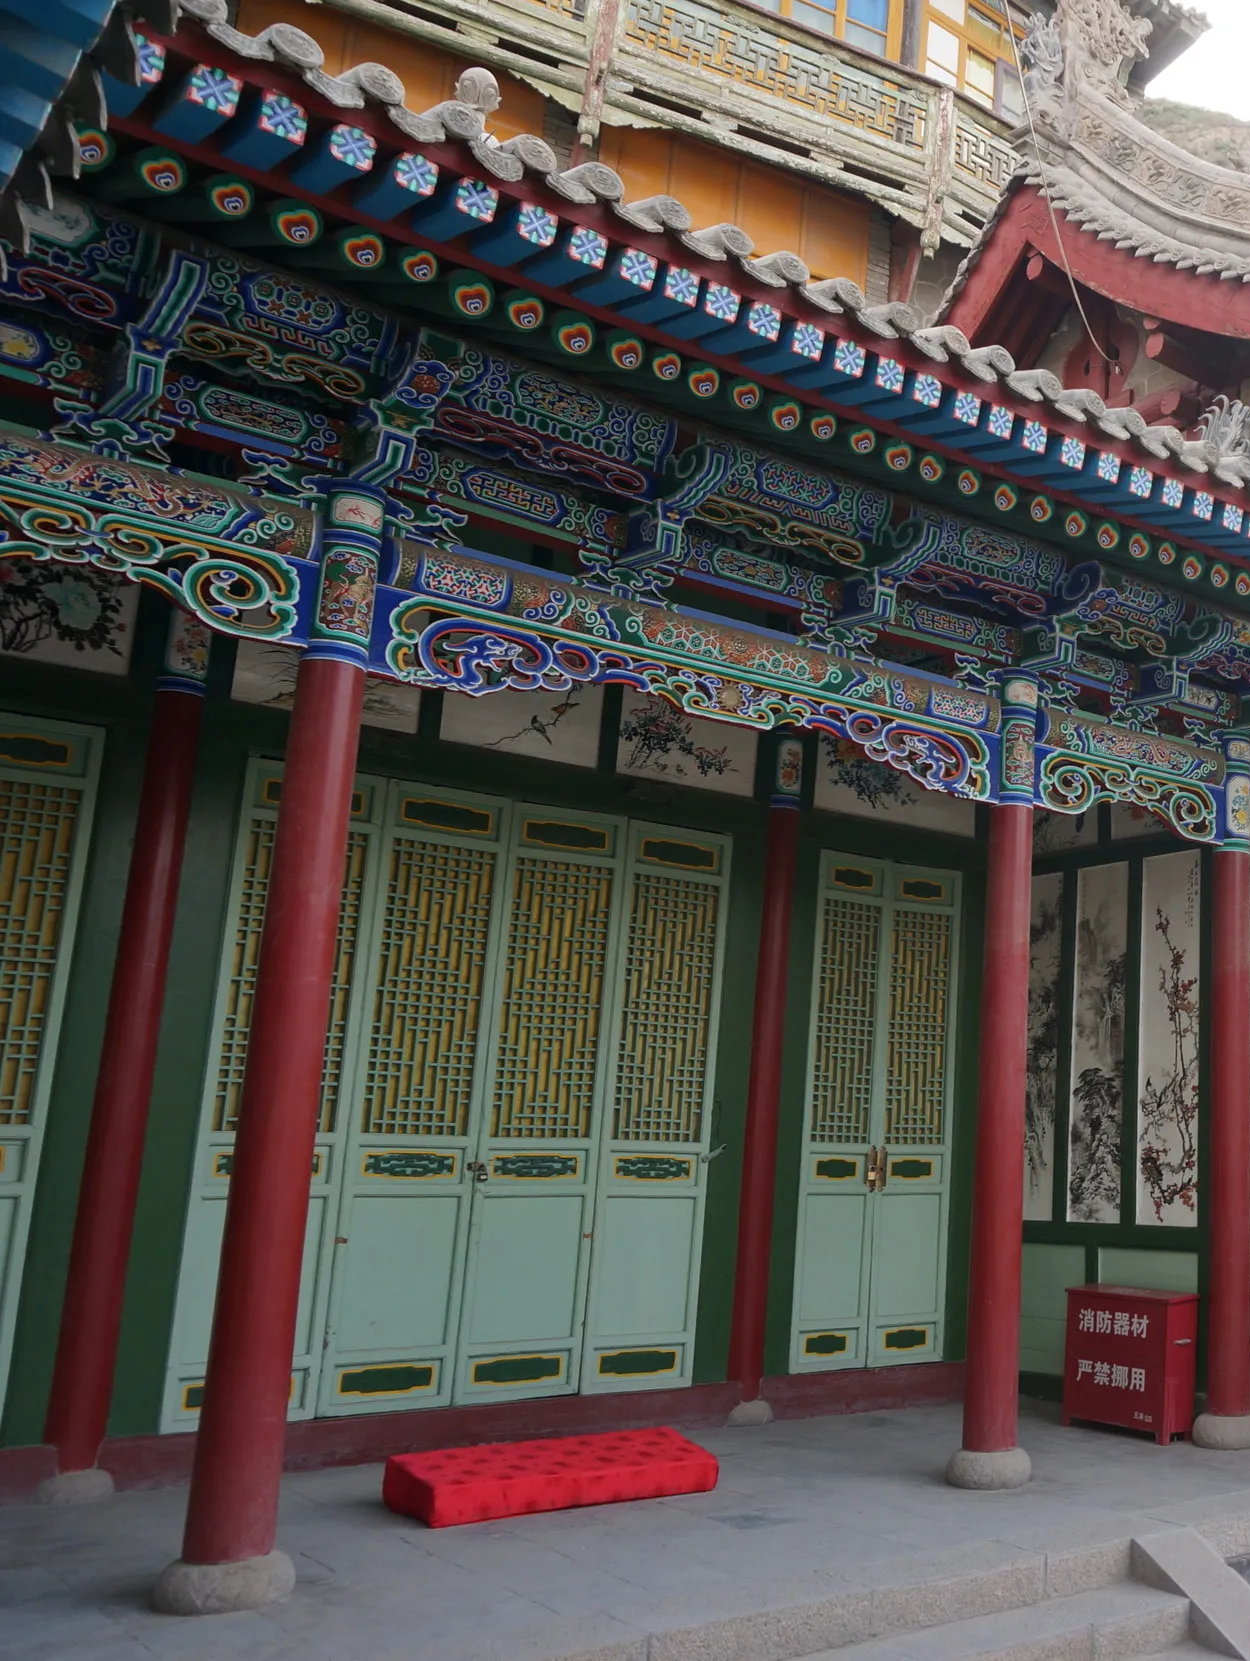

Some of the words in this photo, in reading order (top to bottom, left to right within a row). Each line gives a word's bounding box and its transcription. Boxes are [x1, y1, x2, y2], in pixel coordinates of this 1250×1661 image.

[1078, 1308, 1149, 1339] 消防器材
[1076, 1359, 1146, 1392] 严禁挪用
